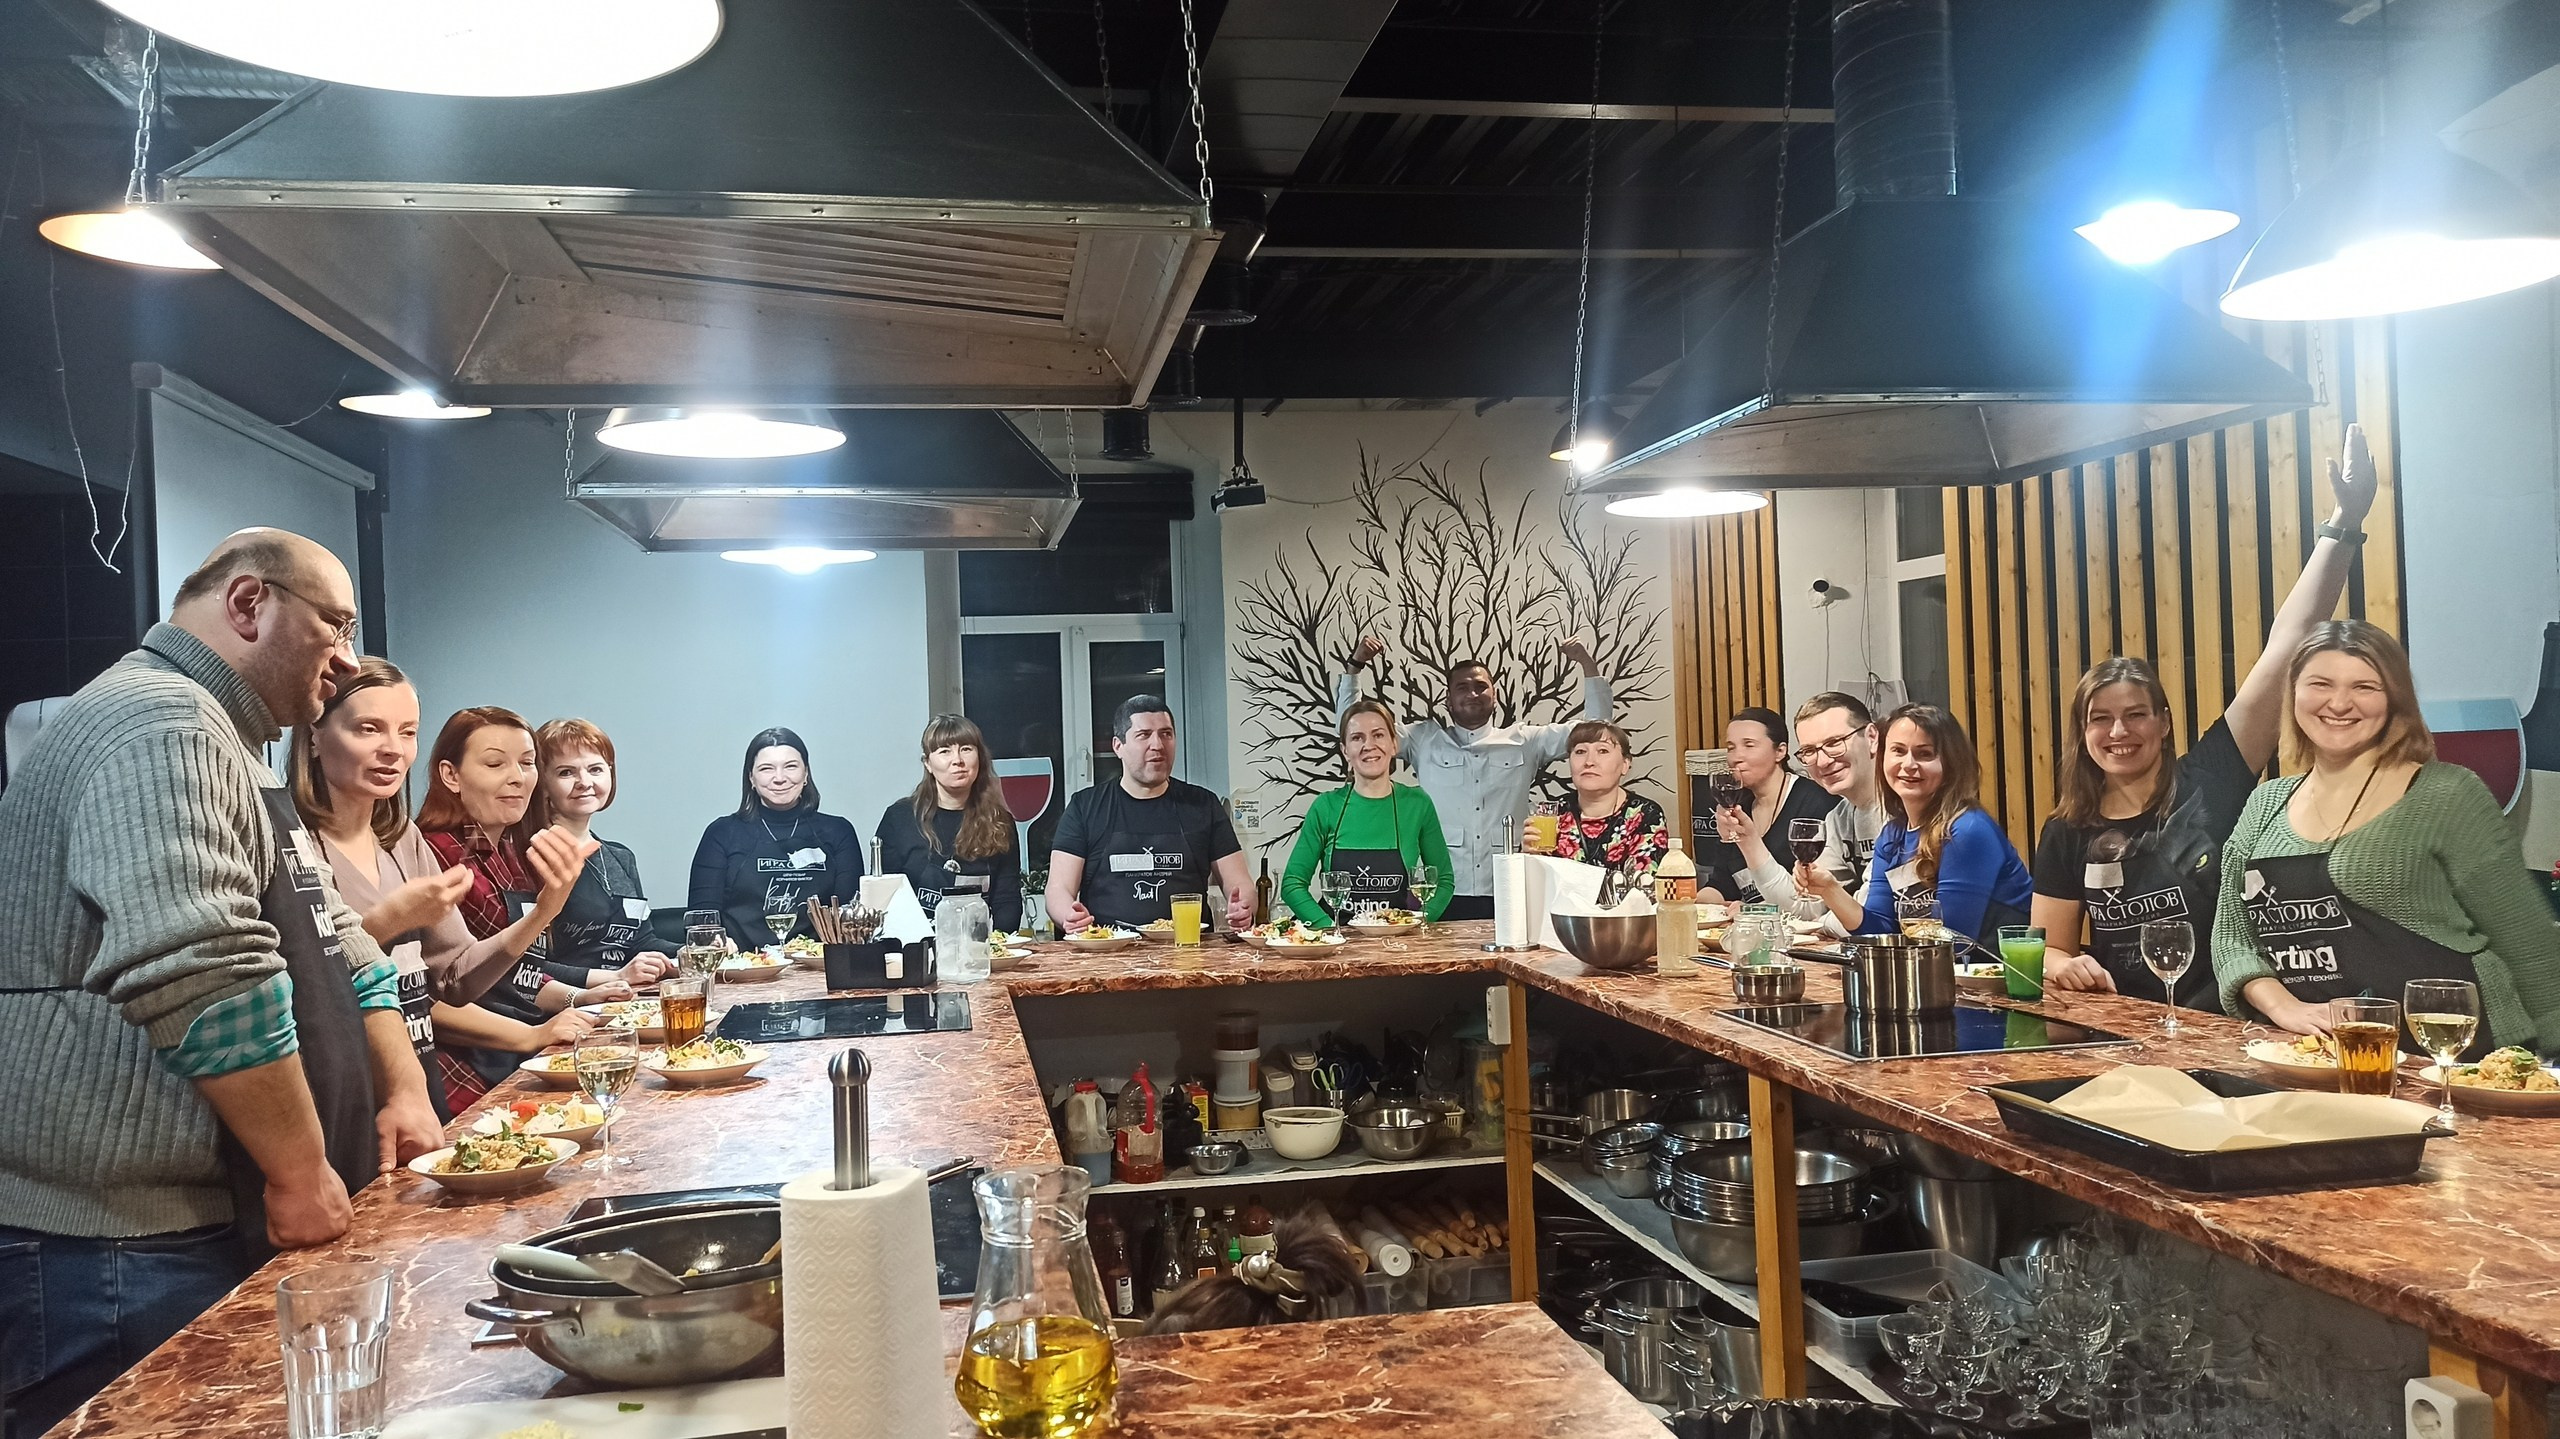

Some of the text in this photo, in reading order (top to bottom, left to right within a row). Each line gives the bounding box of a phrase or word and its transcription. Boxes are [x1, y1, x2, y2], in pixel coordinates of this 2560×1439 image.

[920, 890, 941, 904] ИГР
[1344, 897, 1390, 913] örting
[405, 1013, 435, 1043] ting
